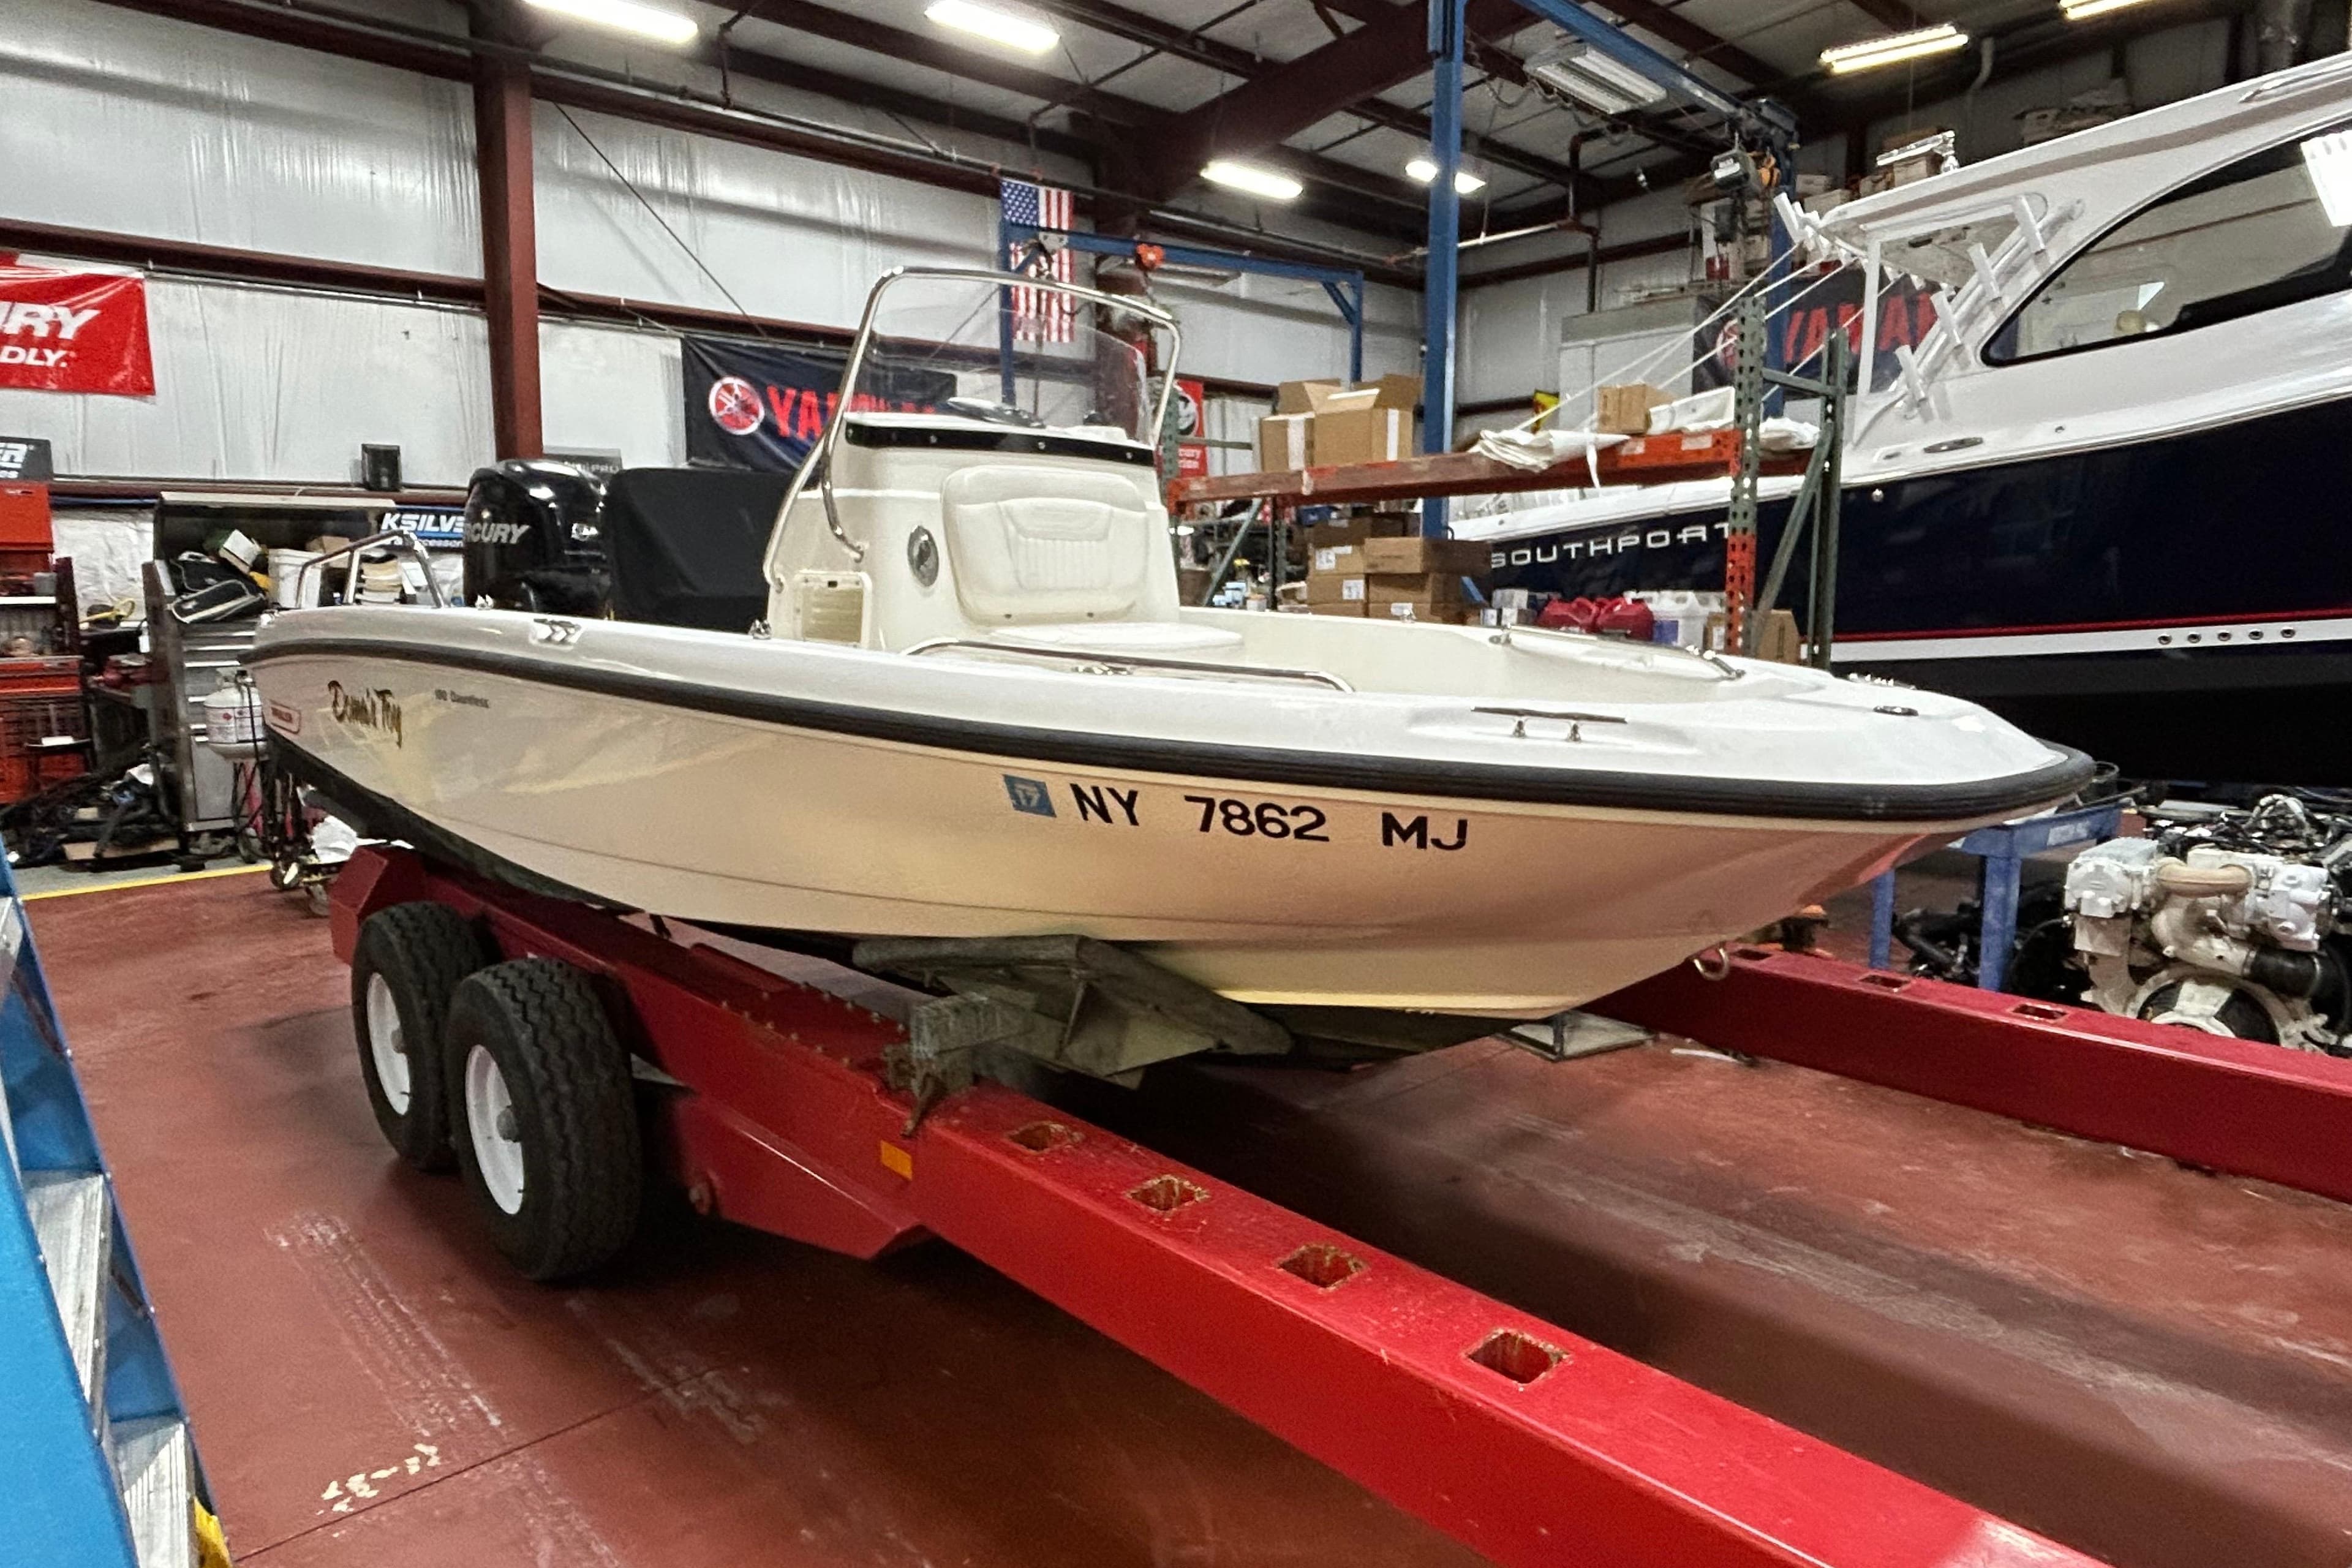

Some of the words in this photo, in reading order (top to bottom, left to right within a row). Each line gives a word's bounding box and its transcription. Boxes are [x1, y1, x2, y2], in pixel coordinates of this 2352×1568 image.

[1069, 783, 1139, 827] NY
[1184, 795, 1330, 843] 7862
[1382, 812, 1468, 851] MJ
